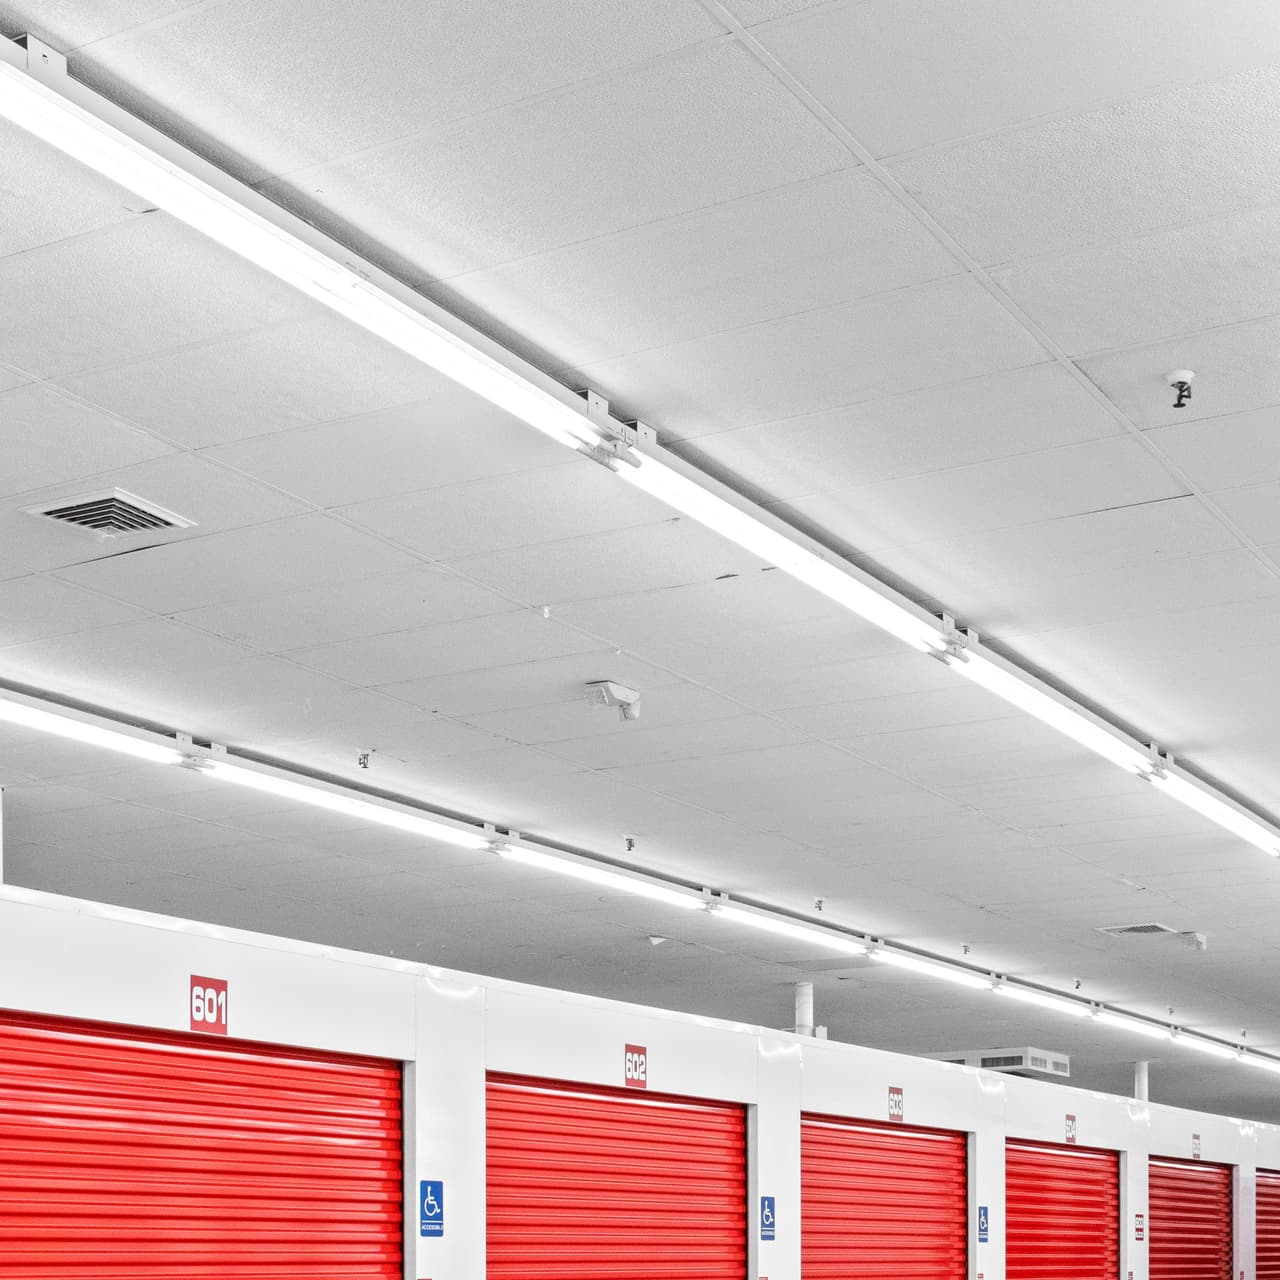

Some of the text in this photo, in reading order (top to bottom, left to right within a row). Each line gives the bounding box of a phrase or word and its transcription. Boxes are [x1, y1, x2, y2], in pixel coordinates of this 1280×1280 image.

[192, 986, 226, 1025] 601
[626, 1052, 646, 1080] 602
[889, 1093, 903, 1116] 603
